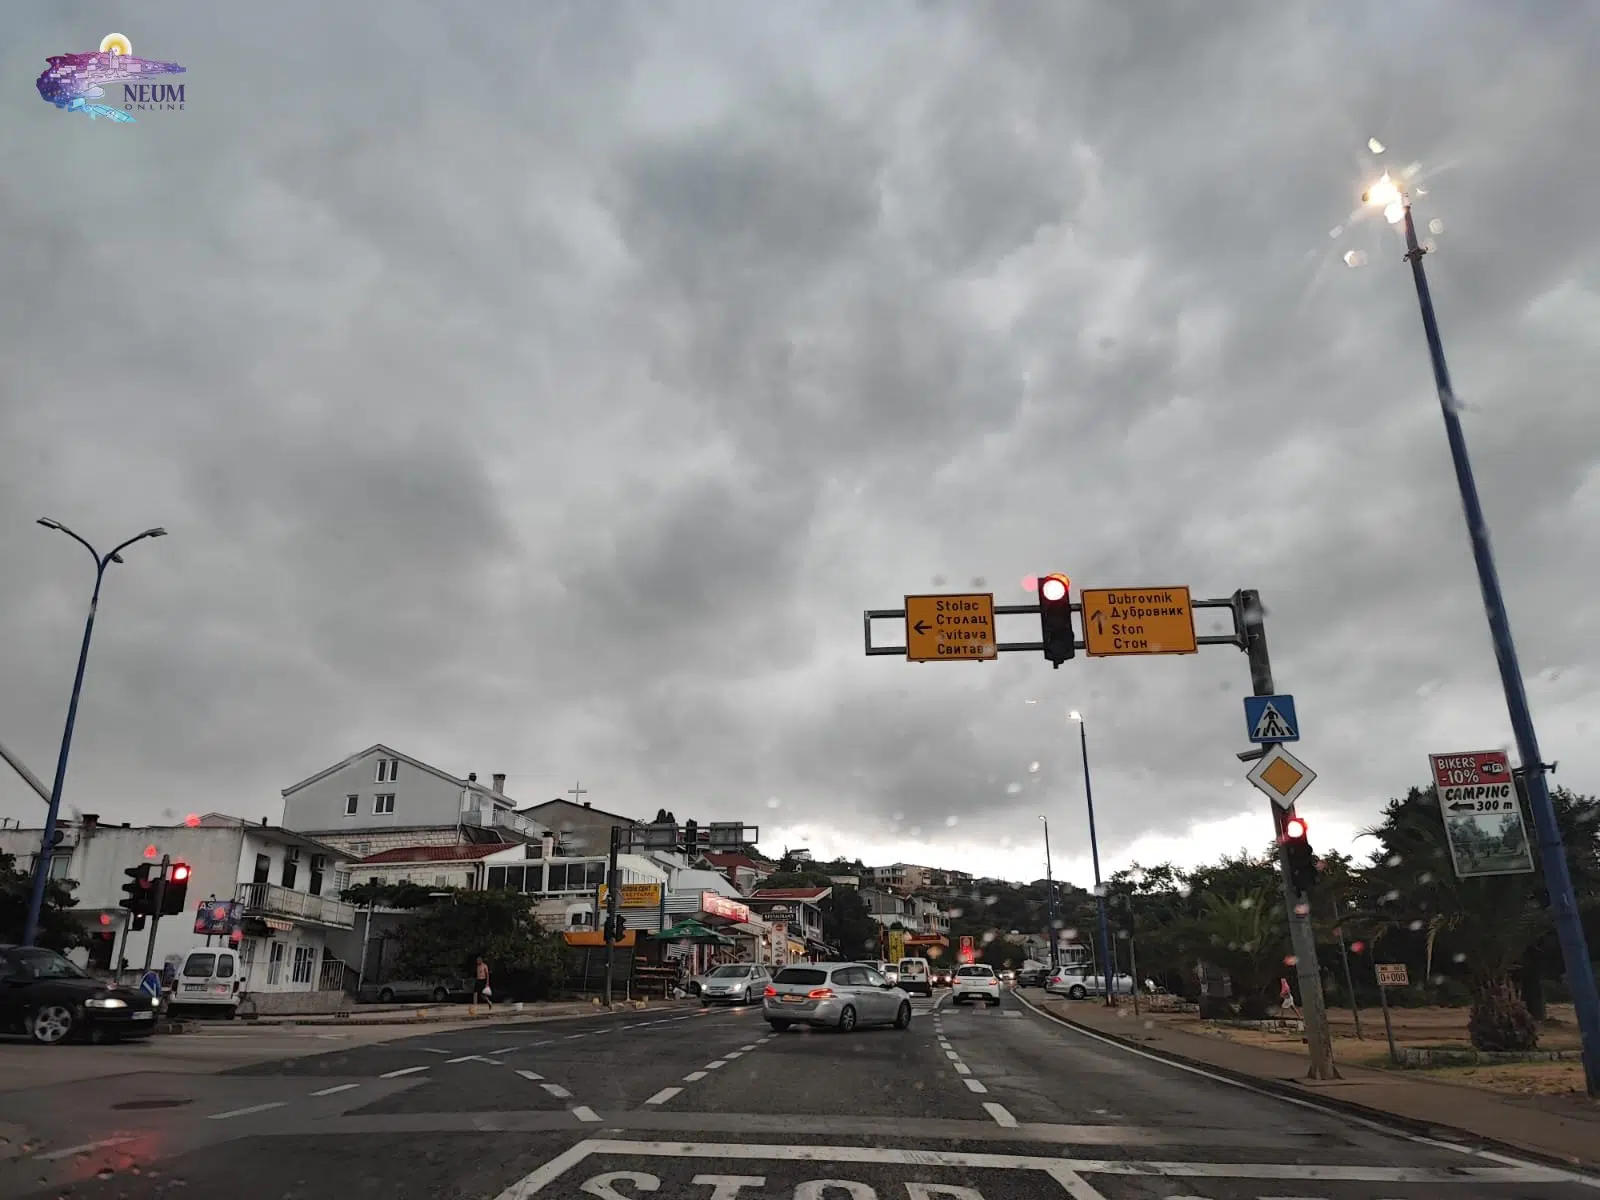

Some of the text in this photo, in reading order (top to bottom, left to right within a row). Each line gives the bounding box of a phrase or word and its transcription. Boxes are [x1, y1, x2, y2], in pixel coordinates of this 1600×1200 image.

[1108, 592, 1173, 604] Dubrovnik
[936, 600, 980, 611] Stolac
[1110, 606, 1184, 620] Дубровник
[936, 614, 989, 625] Столац
[1112, 624, 1144, 635] Ston
[937, 643, 991, 655] Свитав
[1113, 638, 1148, 649] Стон
[1438, 757, 1476, 770] BIKERS
[1440, 769, 1480, 784] -10%
[1445, 785, 1510, 801] CAMPING
[1477, 800, 1513, 811] 300 m
